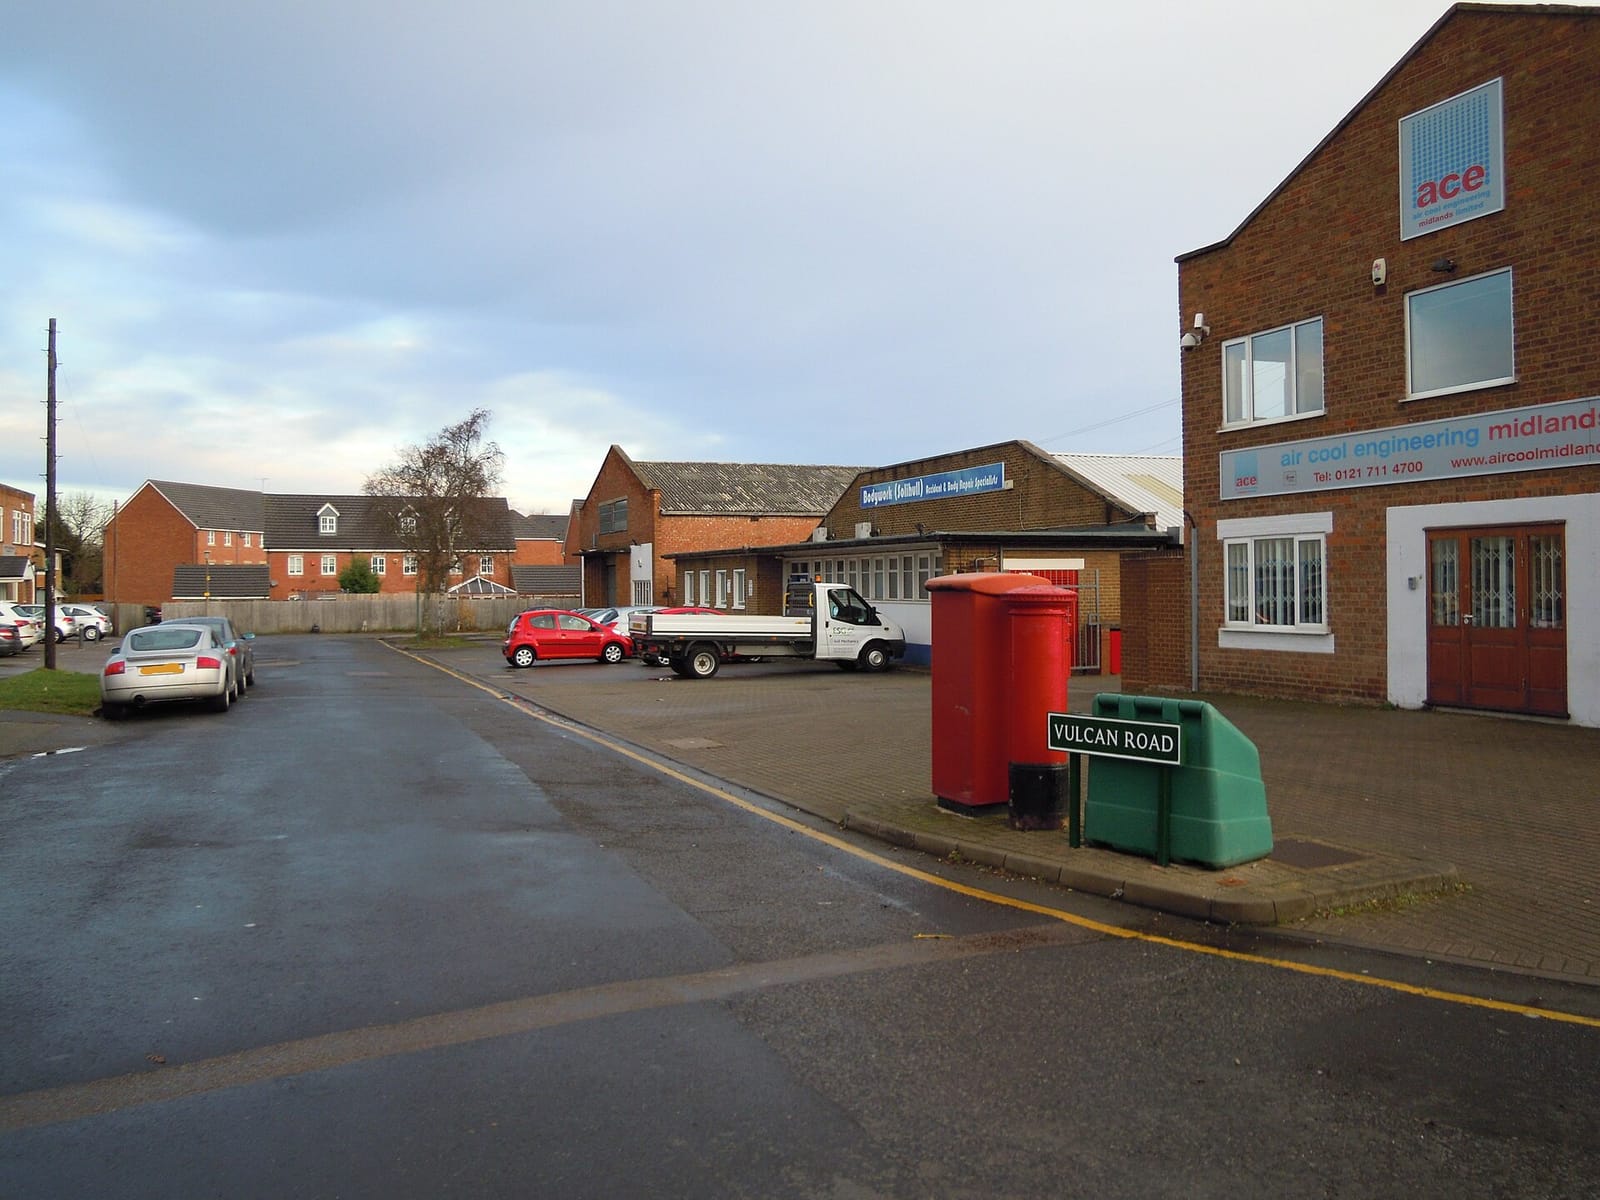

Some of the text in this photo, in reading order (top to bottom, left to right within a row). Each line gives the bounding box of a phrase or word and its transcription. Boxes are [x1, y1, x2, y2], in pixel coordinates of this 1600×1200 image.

[1416, 164, 1485, 208] ace
[1418, 212, 1454, 228] midlands
[1280, 407, 1600, 467] air cool engineering midland
[1235, 475, 1257, 487] ace
[1313, 461, 1423, 483] Tel: 0121 711 4700
[863, 485, 893, 505] Bodywork
[895, 478, 923, 501] (Solihull)
[1054, 723, 1174, 753] VULCAN ROAD
